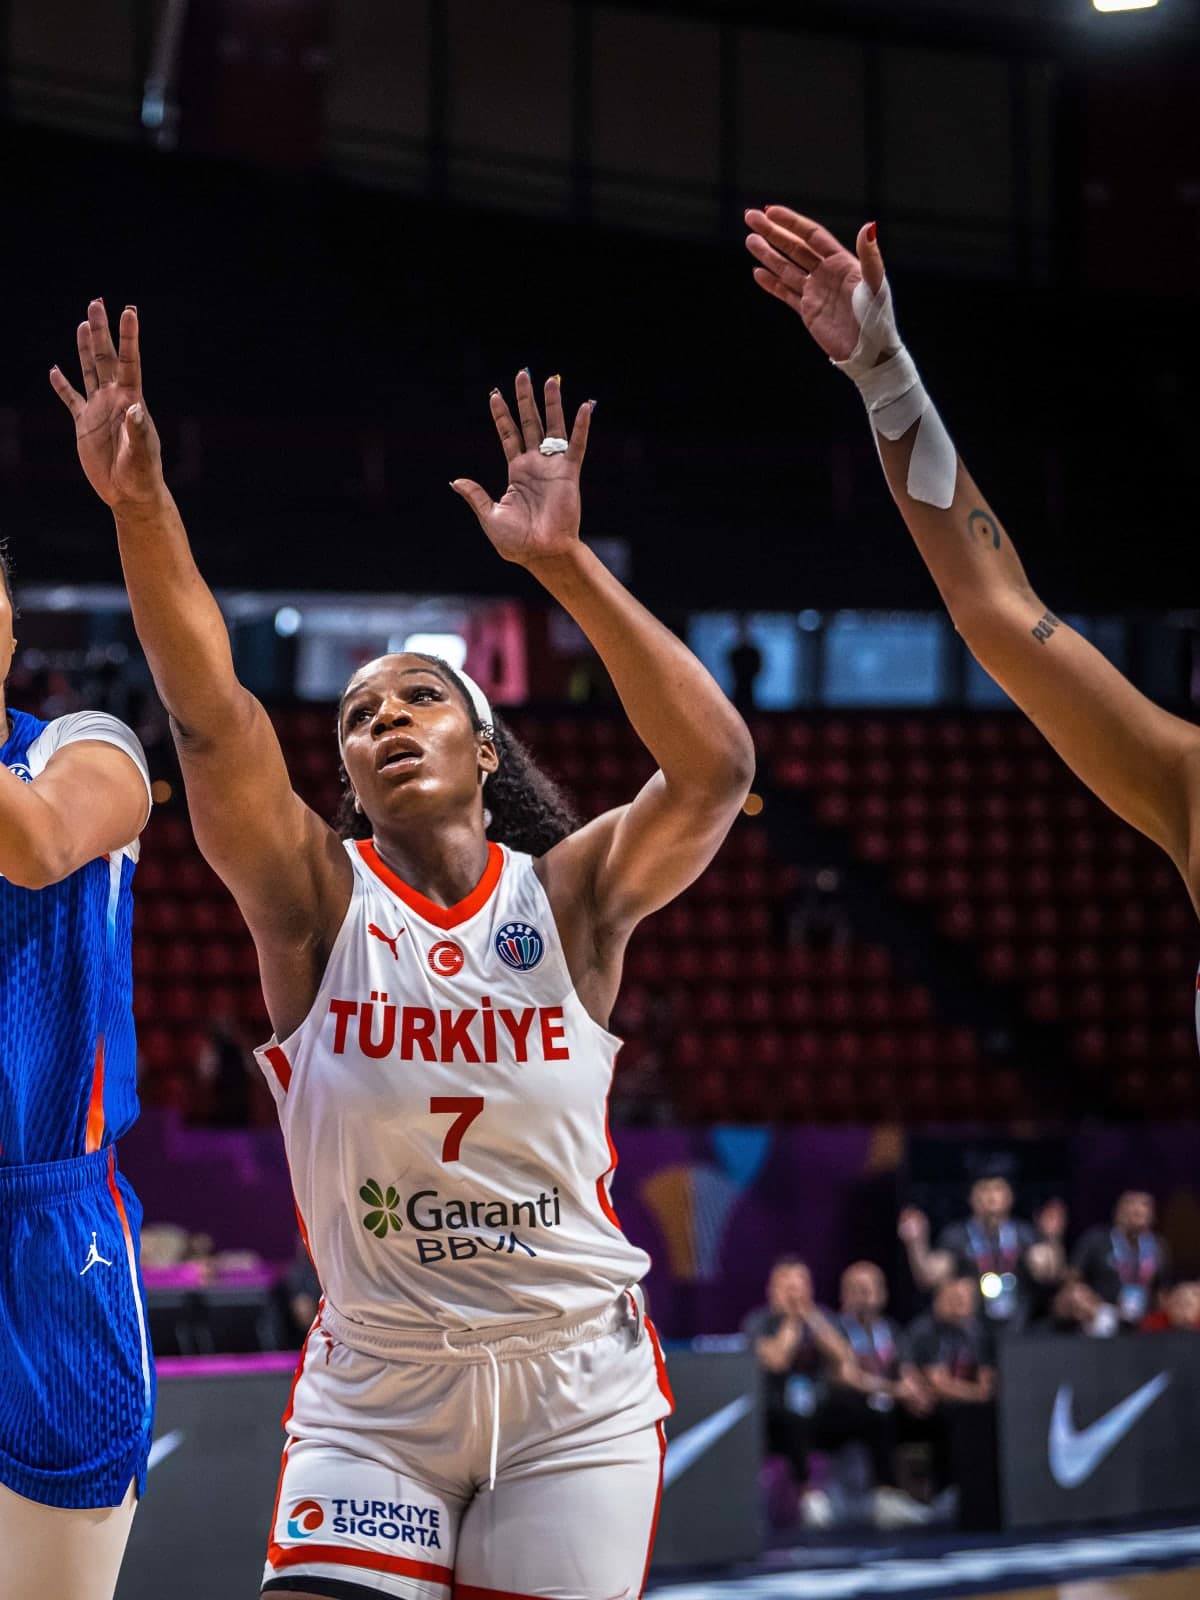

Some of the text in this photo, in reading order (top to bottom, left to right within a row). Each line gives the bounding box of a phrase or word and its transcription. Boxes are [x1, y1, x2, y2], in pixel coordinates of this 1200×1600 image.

[329, 991, 570, 1064] TÜRKİYE
[429, 1096, 485, 1163] 7
[406, 1187, 561, 1233] Garanti
[415, 1232, 538, 1265] BBVA
[332, 1517, 442, 1549] SİGORTA
